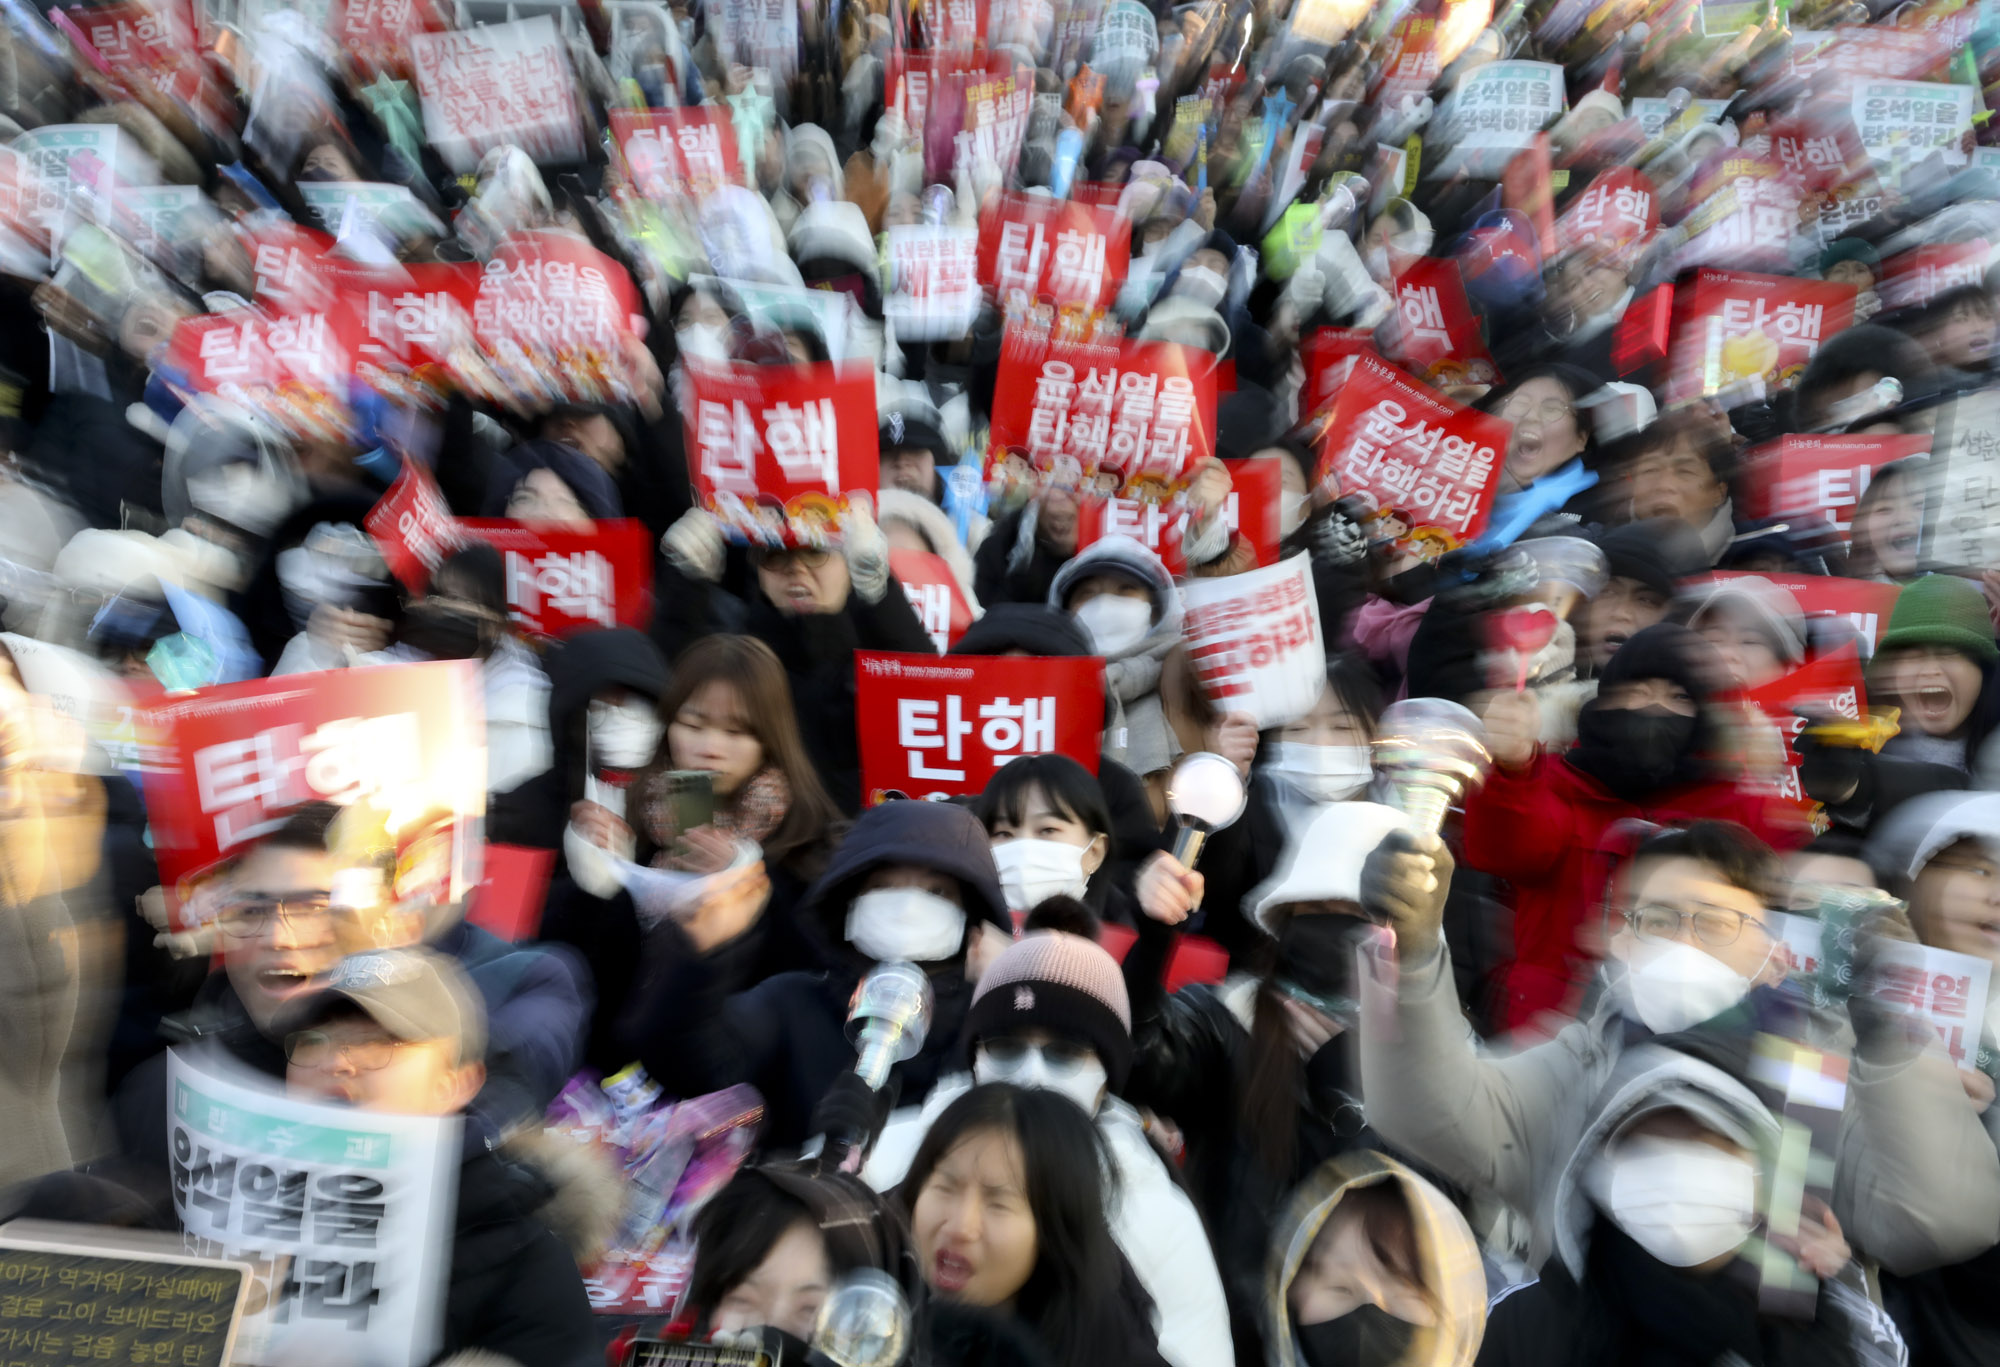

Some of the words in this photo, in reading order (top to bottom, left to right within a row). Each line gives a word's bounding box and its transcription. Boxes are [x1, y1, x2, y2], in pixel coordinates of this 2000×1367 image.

[91, 8, 175, 60] 탄핵
[1461, 80, 1552, 107] 윤석열을
[1864, 98, 1959, 125] 윤석열을
[1778, 134, 1851, 176] 탄핵
[1577, 184, 1652, 233] 탄핵
[480, 257, 608, 304] 윤석열을
[998, 220, 1108, 300] 탄핵
[199, 312, 327, 379] 탄핵
[474, 298, 607, 343] 탄핵하라
[1050, 338, 1120, 354] www.nanum.com
[1722, 297, 1824, 357] 탄핵
[1036, 359, 1196, 424] 윤석열을
[1364, 356, 1397, 383] 나눔문화
[1395, 379, 1455, 417] www.nanum.com
[697, 396, 841, 502] 탄핵
[1027, 407, 1193, 473] 탄핵하라
[1362, 399, 1496, 490] 윤석열을
[1344, 437, 1481, 534] 탄핵하라
[902, 665, 975, 680] www.nanum.com
[897, 694, 1056, 782] 탄핵
[193, 711, 420, 852] 탄핵
[57, 1266, 125, 1295] 역겨워
[131, 1273, 223, 1304] 가실때에
[50, 1299, 97, 1325] 고이
[102, 1304, 216, 1334] 보내드리오
[0, 1328, 64, 1355] 가시는
[71, 1334, 117, 1360] 걸음
